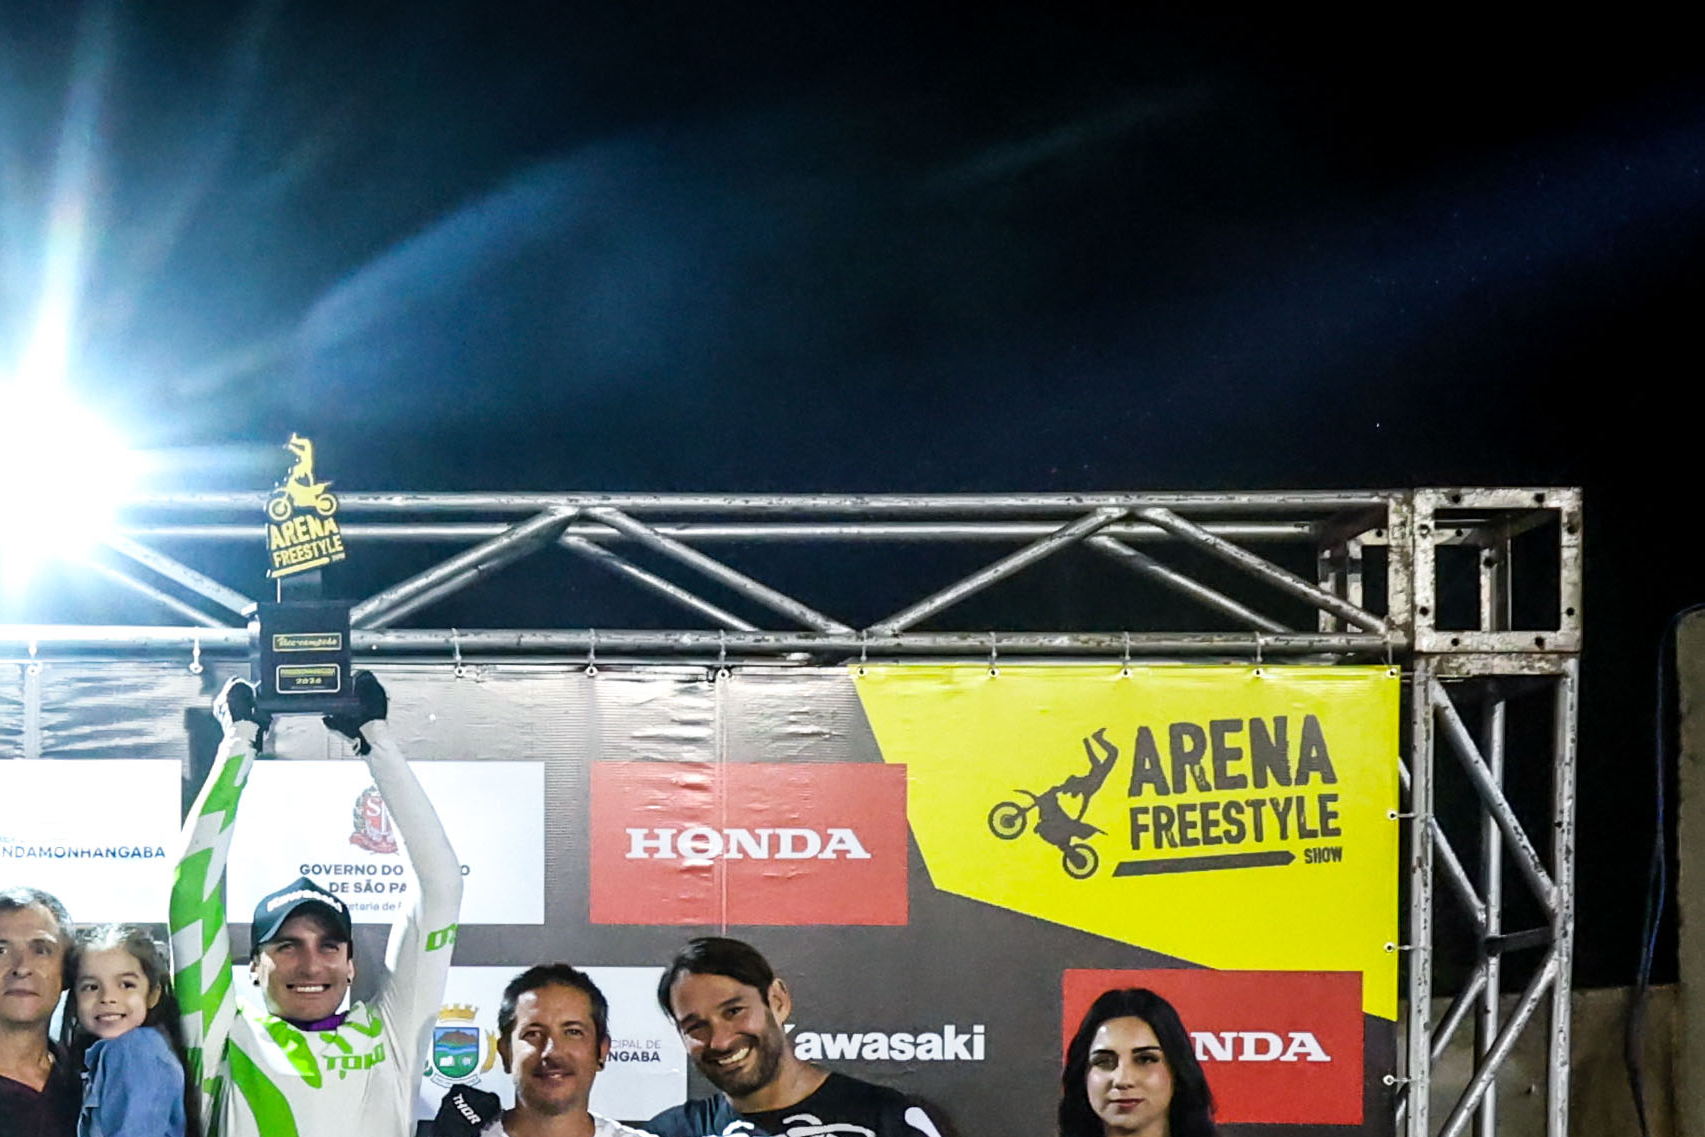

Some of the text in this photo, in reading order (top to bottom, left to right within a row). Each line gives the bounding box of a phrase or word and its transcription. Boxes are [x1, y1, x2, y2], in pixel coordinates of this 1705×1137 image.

[270, 515, 339, 550] ARENA
[272, 535, 344, 567] FREESTYLE
[1128, 714, 1338, 798] ARENA
[1129, 794, 1342, 850] FREESTYLE
[625, 827, 871, 860] HONDA
[1304, 847, 1342, 865] SHOW
[300, 864, 404, 876] GOVERNO DO
[329, 882, 349, 893] DE
[353, 879, 385, 893] SÃO
[786, 1024, 985, 1061] awasaki
[1192, 1031, 1331, 1062] NDA
